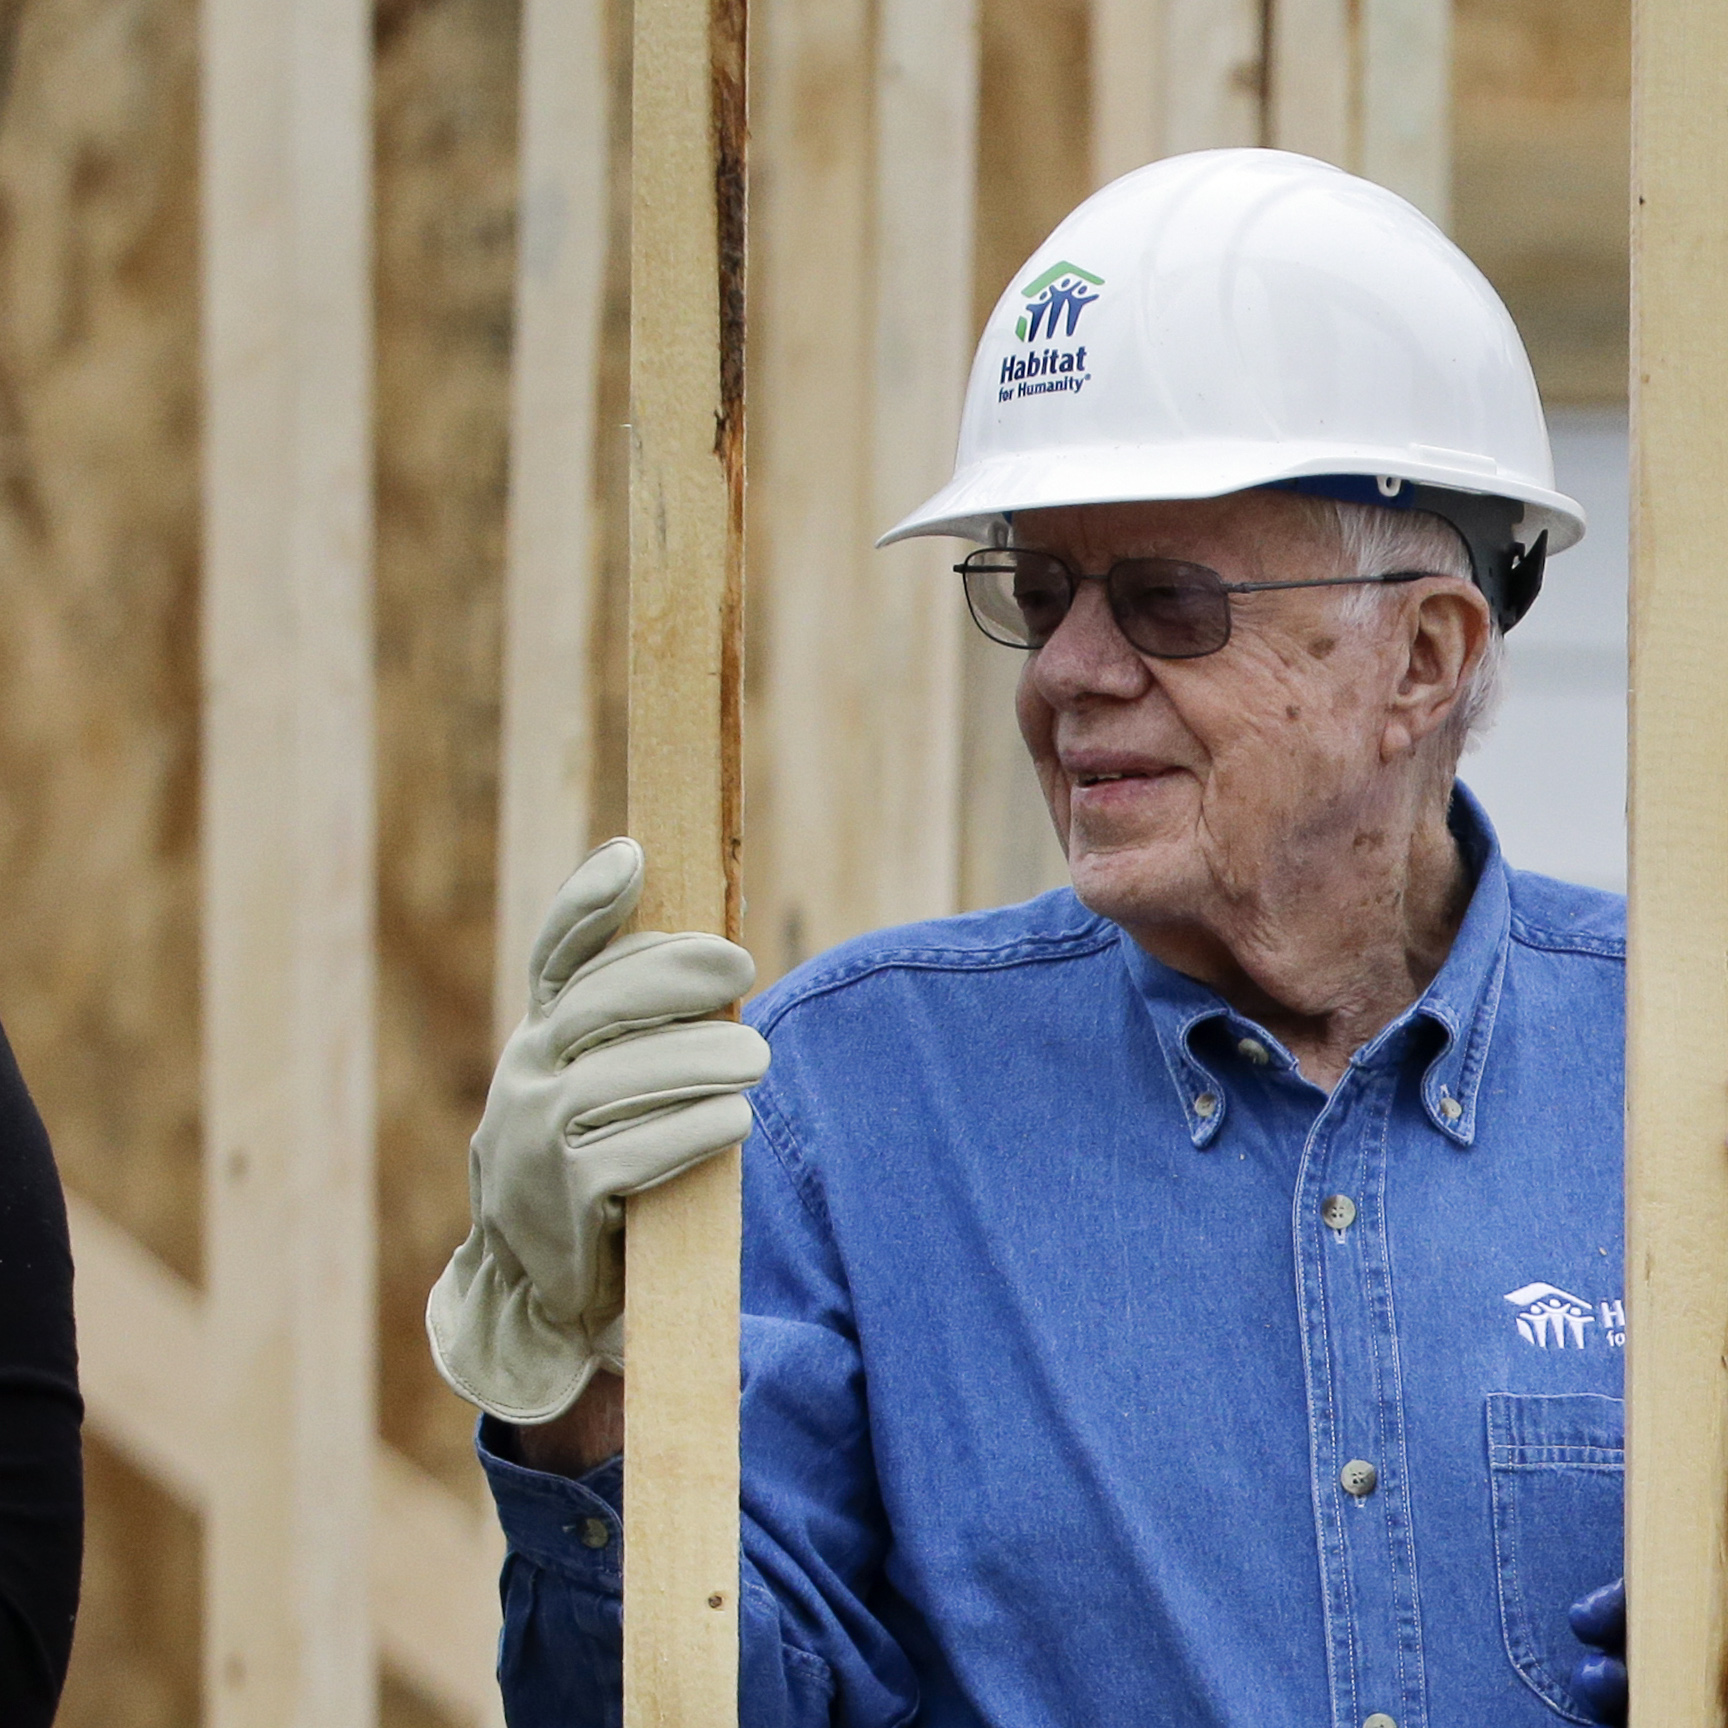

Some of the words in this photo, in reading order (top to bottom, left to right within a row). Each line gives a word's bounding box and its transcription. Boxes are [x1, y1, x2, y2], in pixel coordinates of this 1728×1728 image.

[1000, 346, 1087, 384] Habitat
[998, 387, 1014, 403] for
[1018, 376, 1085, 398] Humanity
